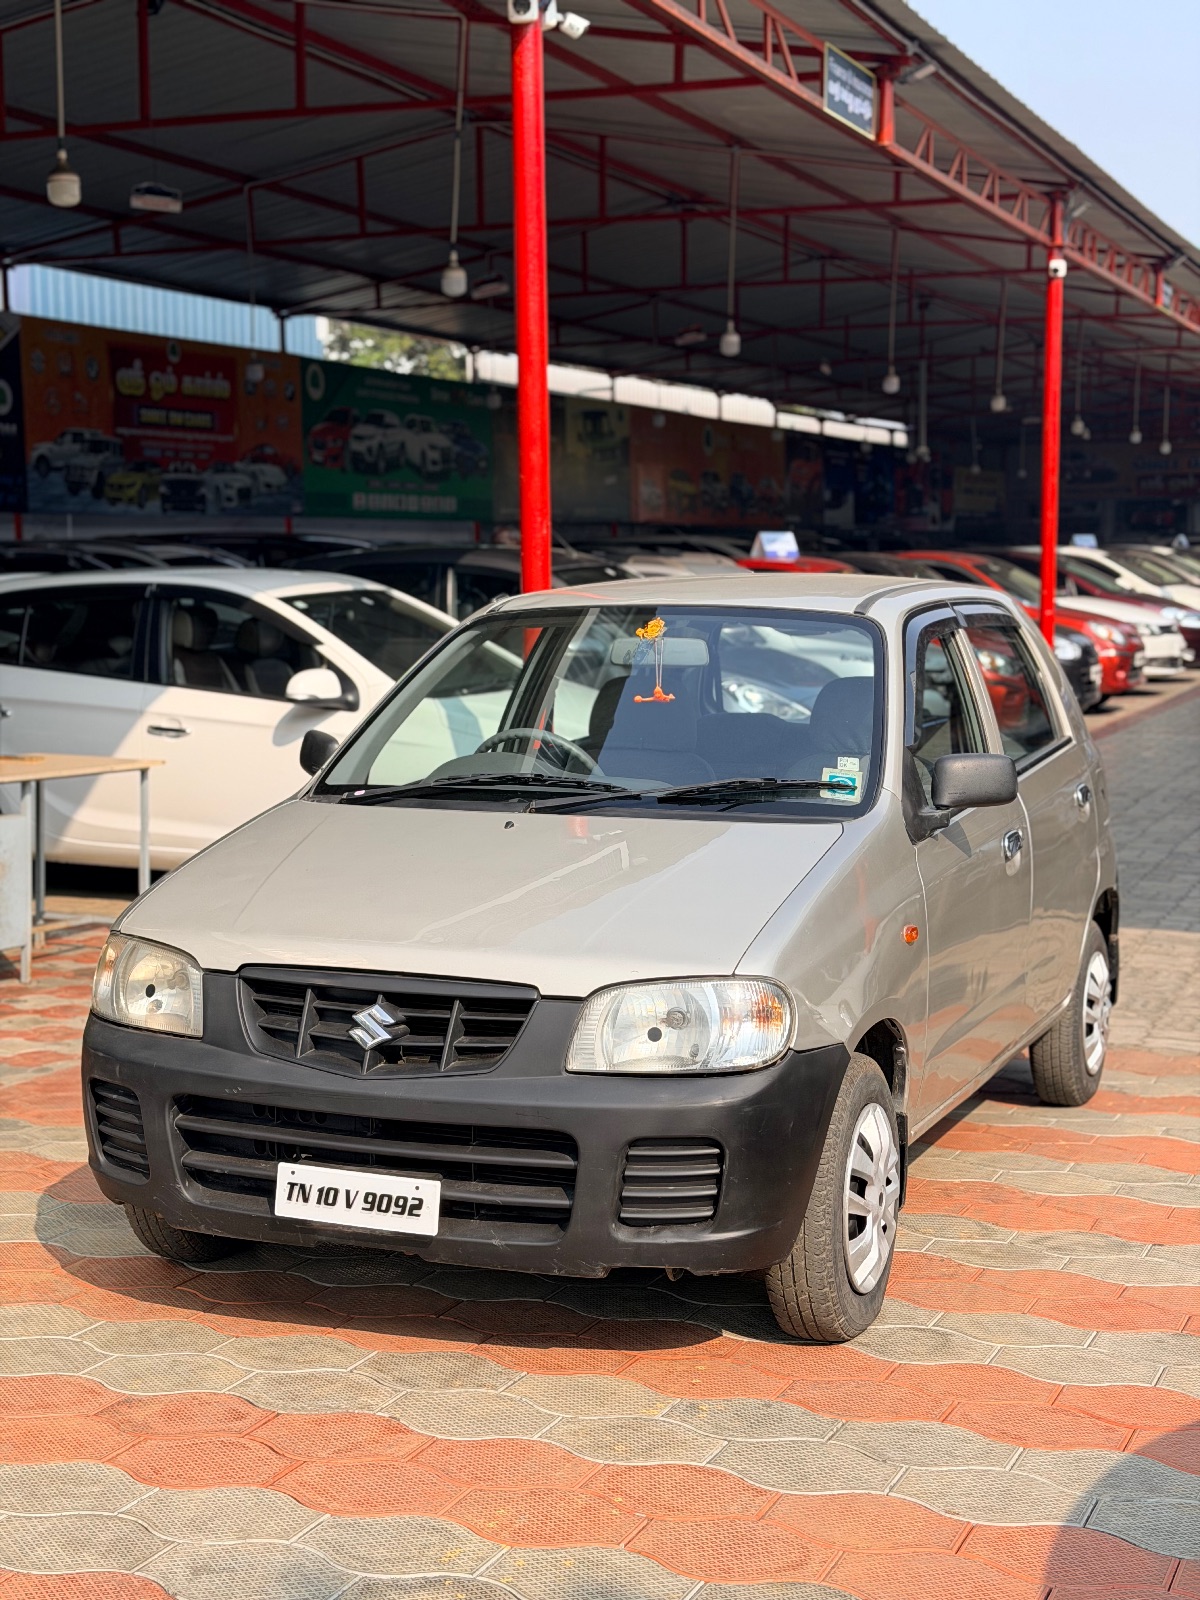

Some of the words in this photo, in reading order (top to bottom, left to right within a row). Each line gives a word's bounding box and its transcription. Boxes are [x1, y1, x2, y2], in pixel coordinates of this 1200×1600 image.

[286, 1182, 312, 1203] TN
[316, 1186, 339, 1206] 10
[345, 1189, 359, 1209] V
[361, 1192, 424, 1217] 9092
